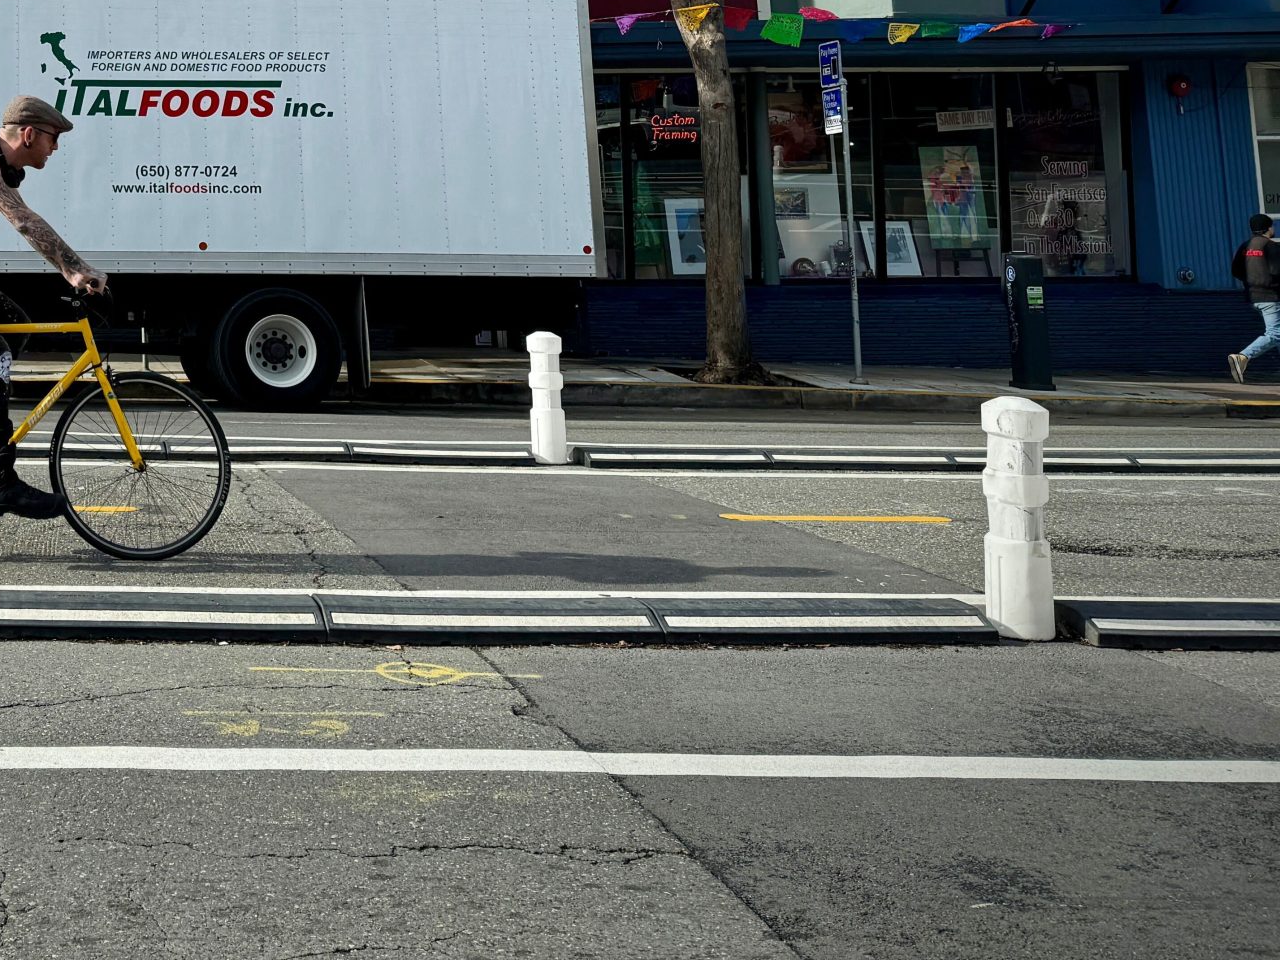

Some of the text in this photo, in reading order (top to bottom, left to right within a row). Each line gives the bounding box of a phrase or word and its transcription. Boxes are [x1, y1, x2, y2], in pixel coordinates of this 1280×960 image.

[87, 50, 331, 62] IMPORTERS AND WHOLESALERS OF SELECT
[820, 49, 828, 58] Pay
[91, 62, 327, 74] FOREIGN AND DOMESTIC FOOD PRODUCTS
[283, 97, 334, 118] inc.
[650, 114, 695, 127] Custom
[938, 113, 960, 126] SAME
[961, 111, 975, 125] DAY
[651, 127, 698, 143] Framing
[135, 164, 238, 179] (650) 877-0724
[1041, 156, 1088, 179] Serving
[112, 181, 262, 195] www.italfoodsinc.com
[1025, 182, 1107, 202] San Francisco
[1027, 208, 1074, 228] Over 30
[1023, 234, 1114, 256] in The Mission!
